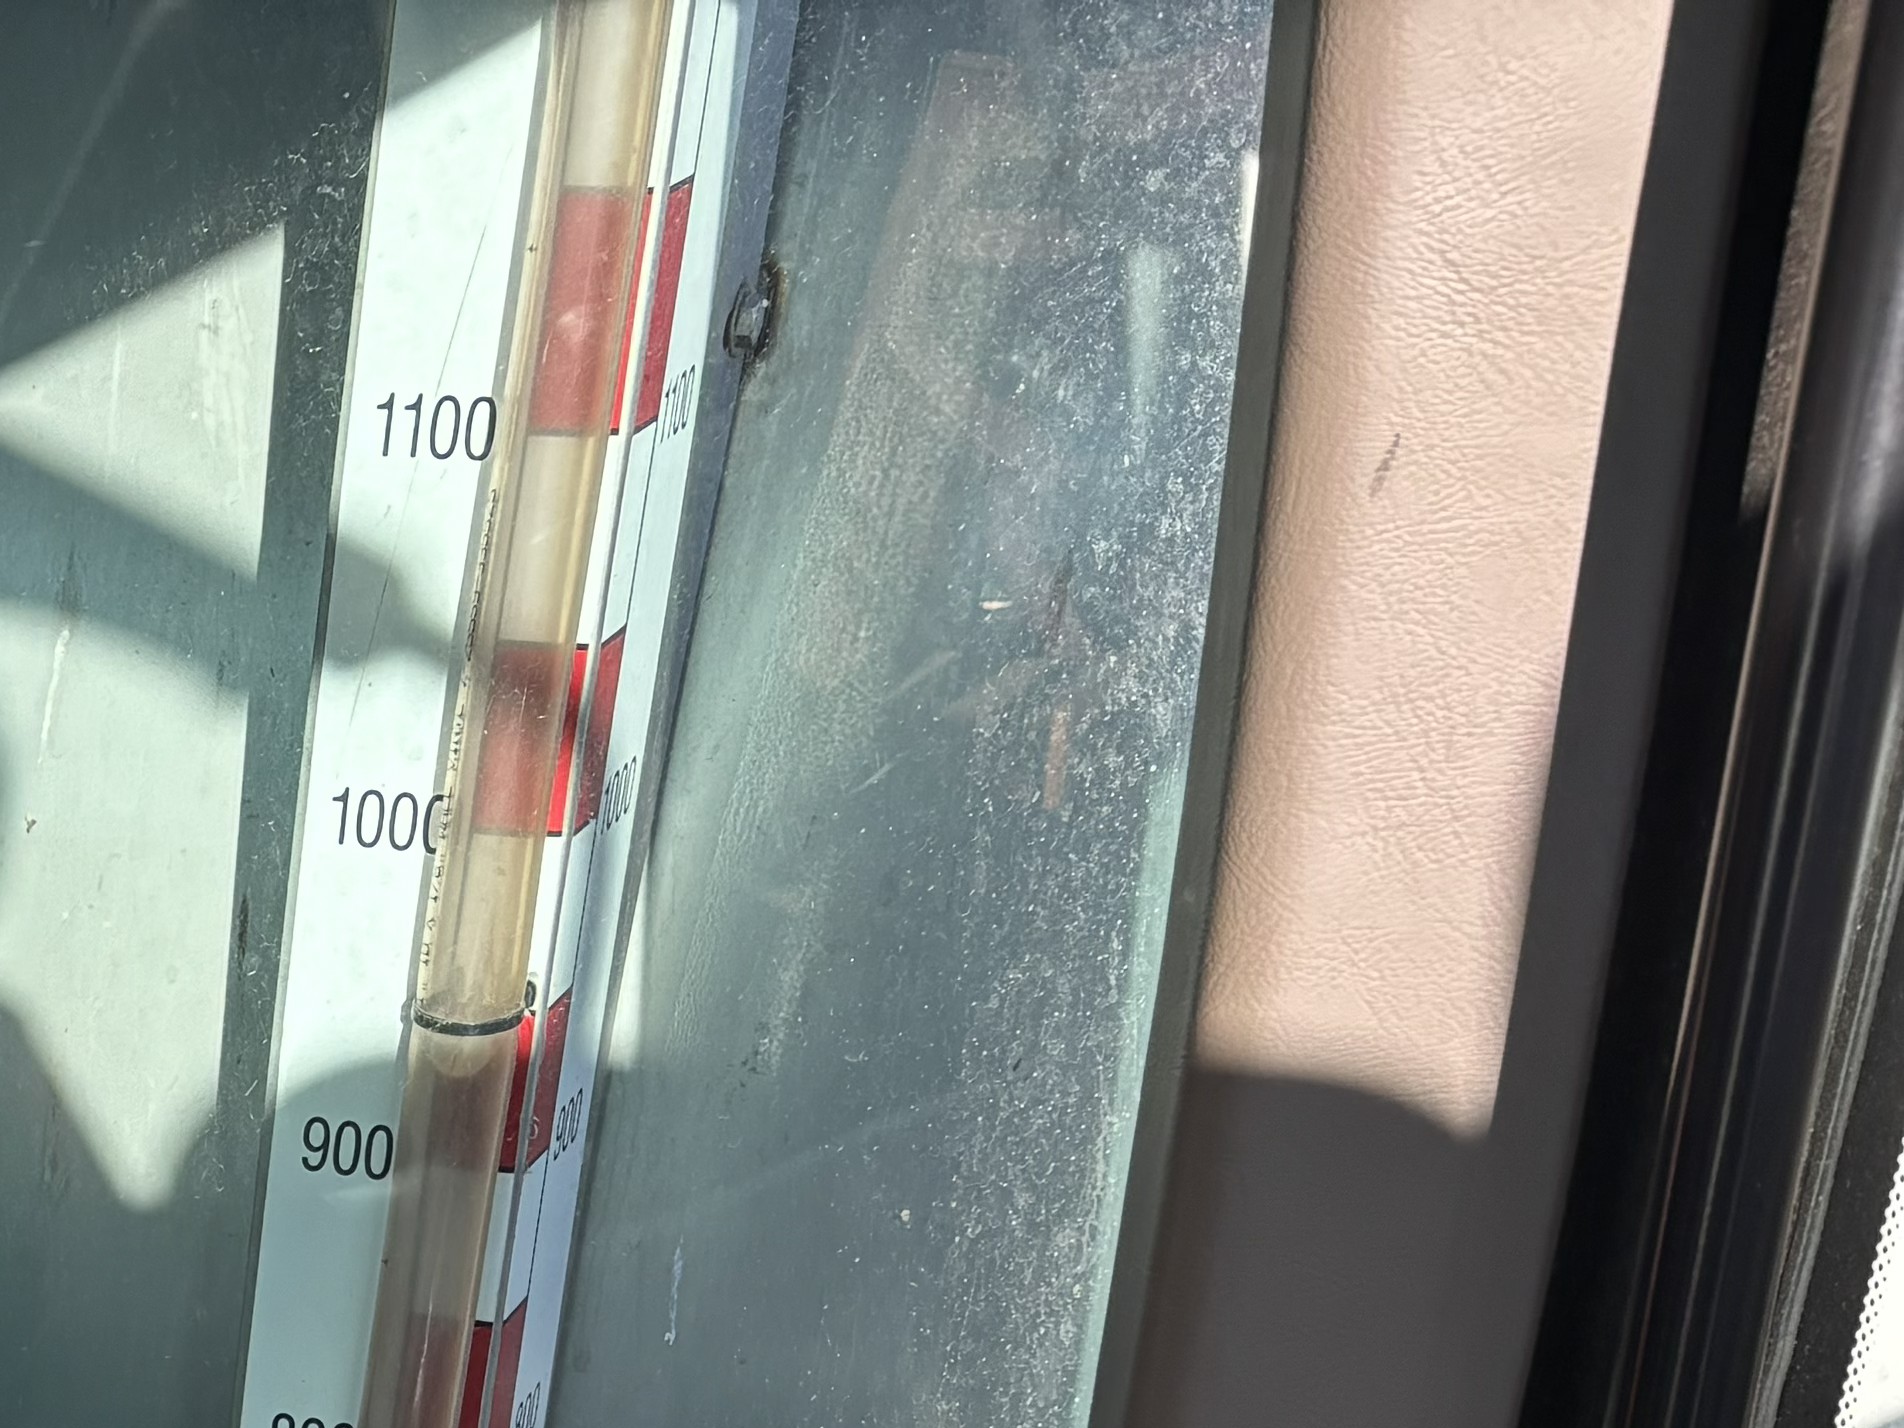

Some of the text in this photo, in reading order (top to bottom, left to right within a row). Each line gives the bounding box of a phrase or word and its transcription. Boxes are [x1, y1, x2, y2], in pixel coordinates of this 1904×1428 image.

[376, 392, 497, 461] 1100
[658, 364, 696, 444] 1100
[599, 755, 638, 836] 1000
[301, 1116, 393, 1180] 900
[553, 1088, 583, 1161] 900
